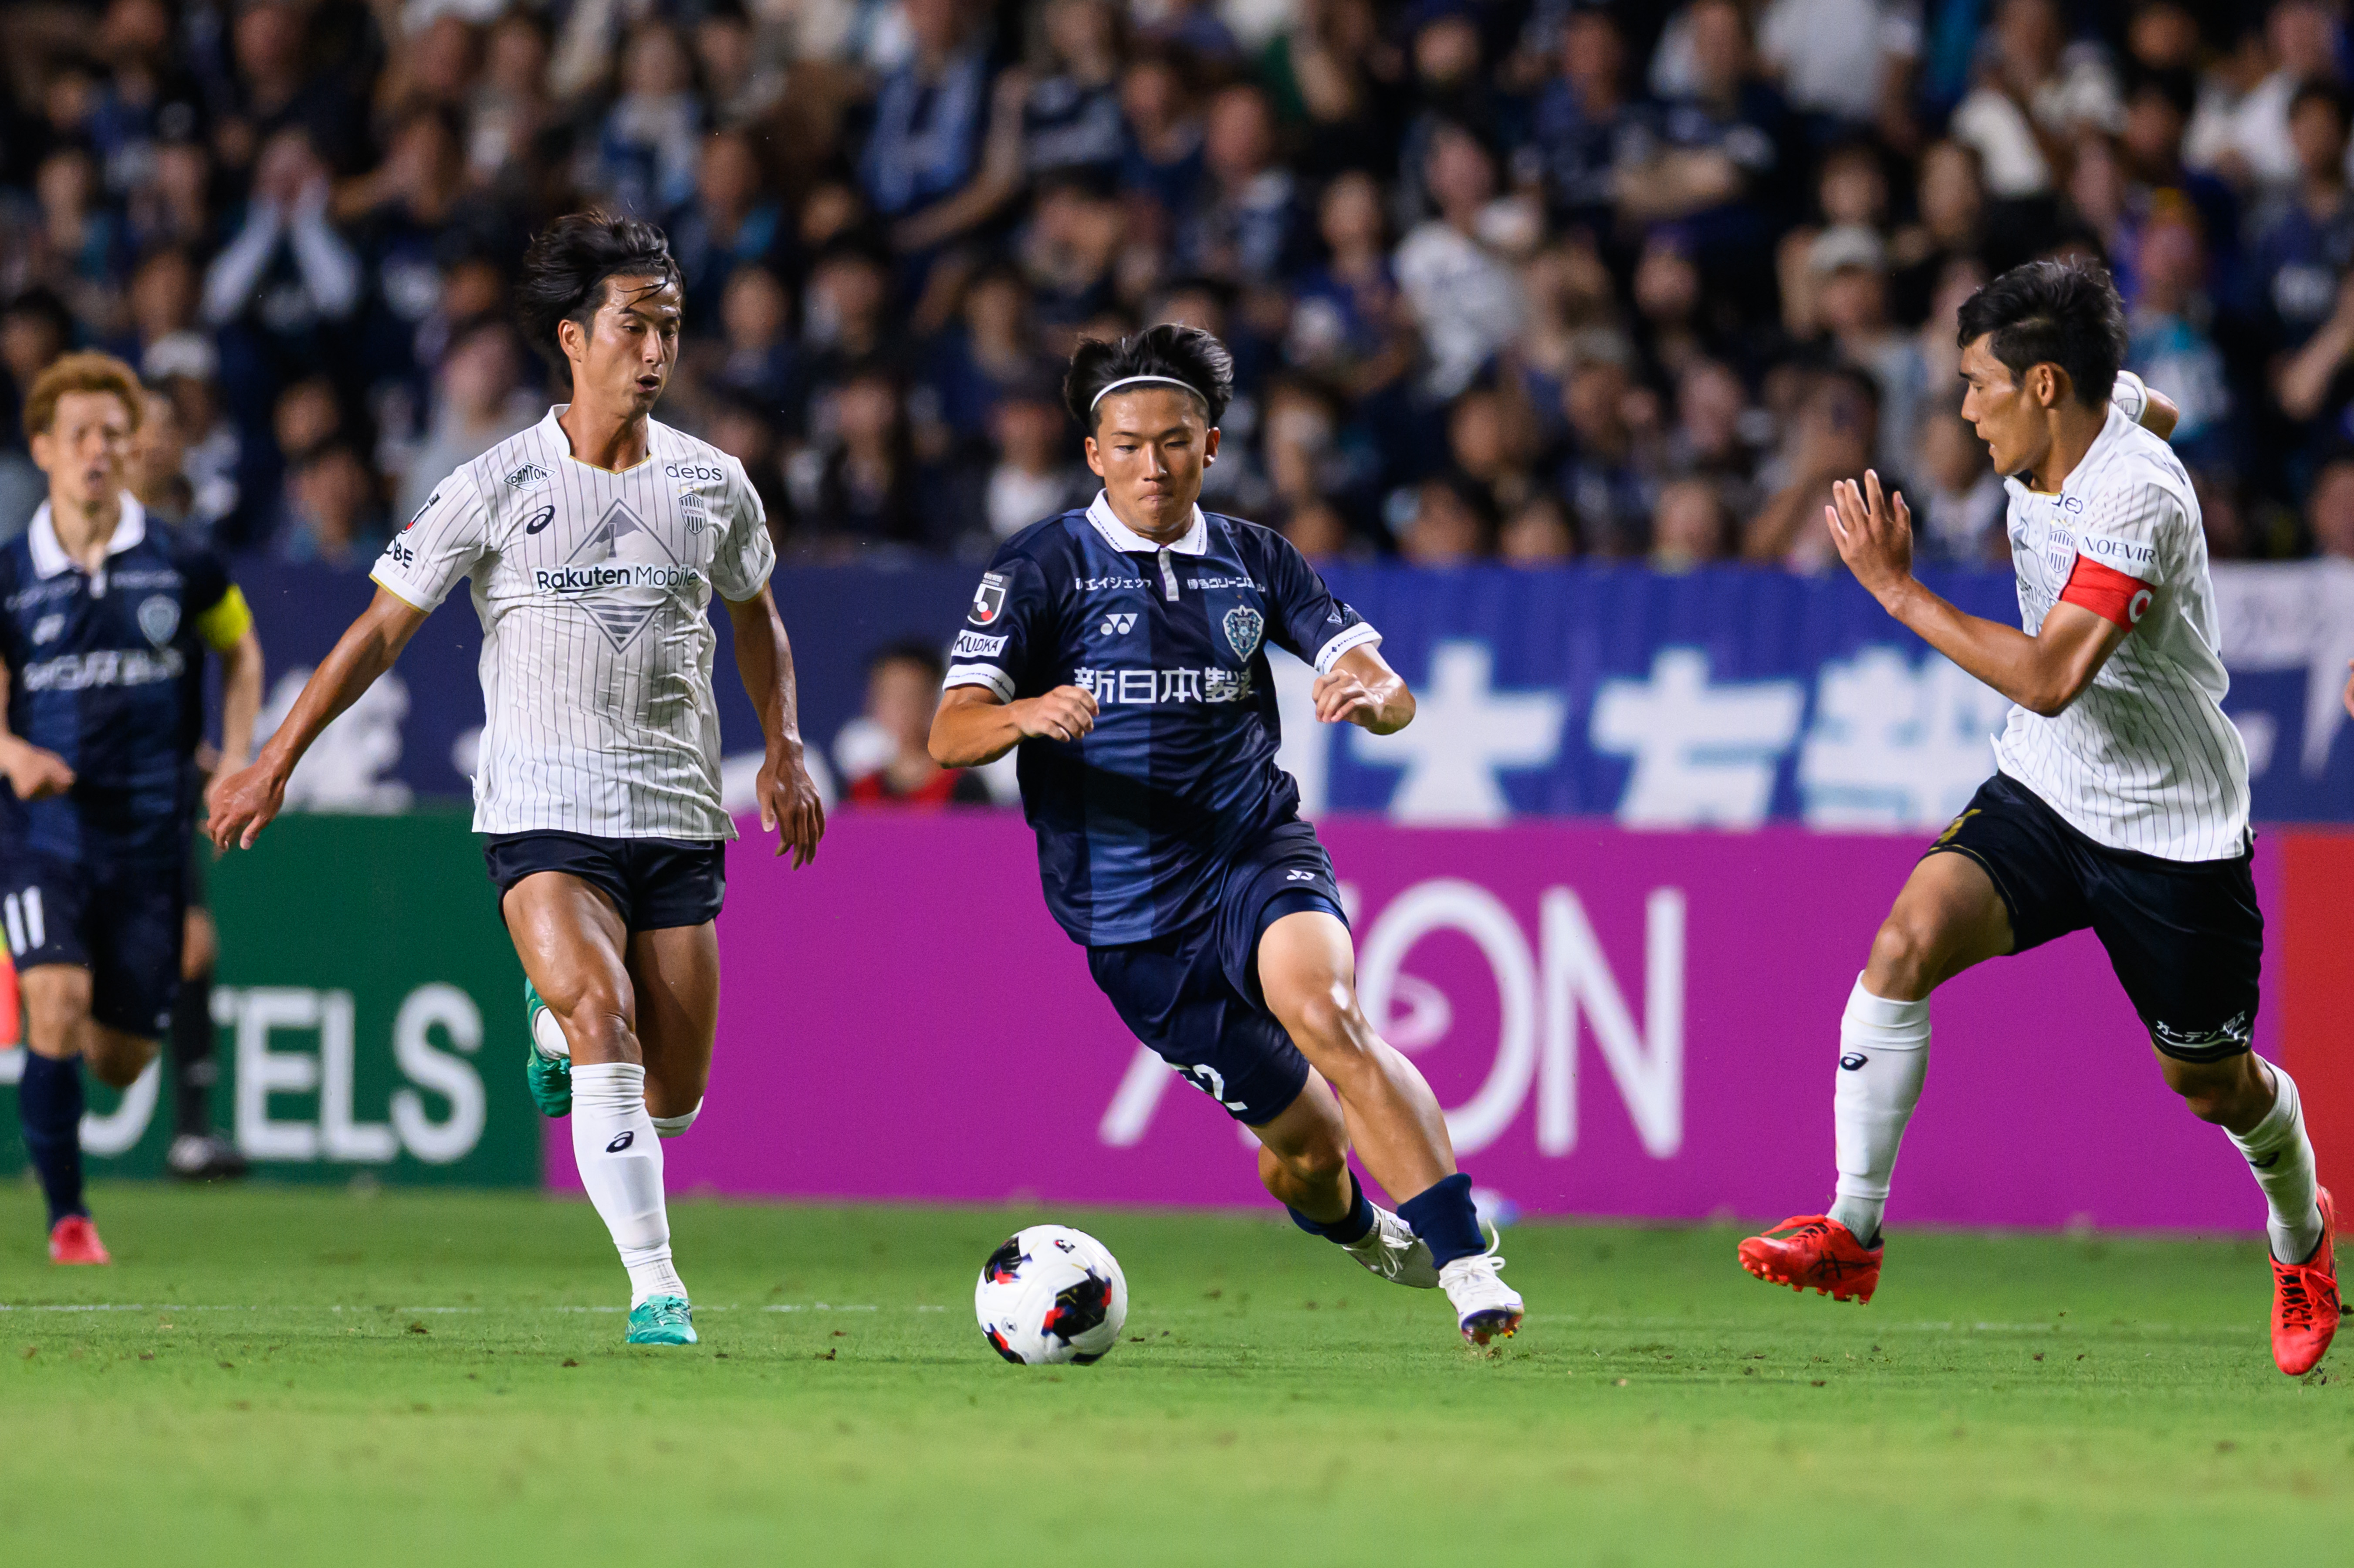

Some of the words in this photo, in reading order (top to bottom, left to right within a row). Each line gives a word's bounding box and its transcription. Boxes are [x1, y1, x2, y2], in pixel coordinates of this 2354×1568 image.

[511, 465, 547, 484] DANTON
[666, 463, 722, 481] debs
[2083, 536, 2156, 564] NOEVIR
[536, 567, 630, 589] Rakuten
[635, 566, 698, 588] Mobile
[3, 886, 46, 957] 11
